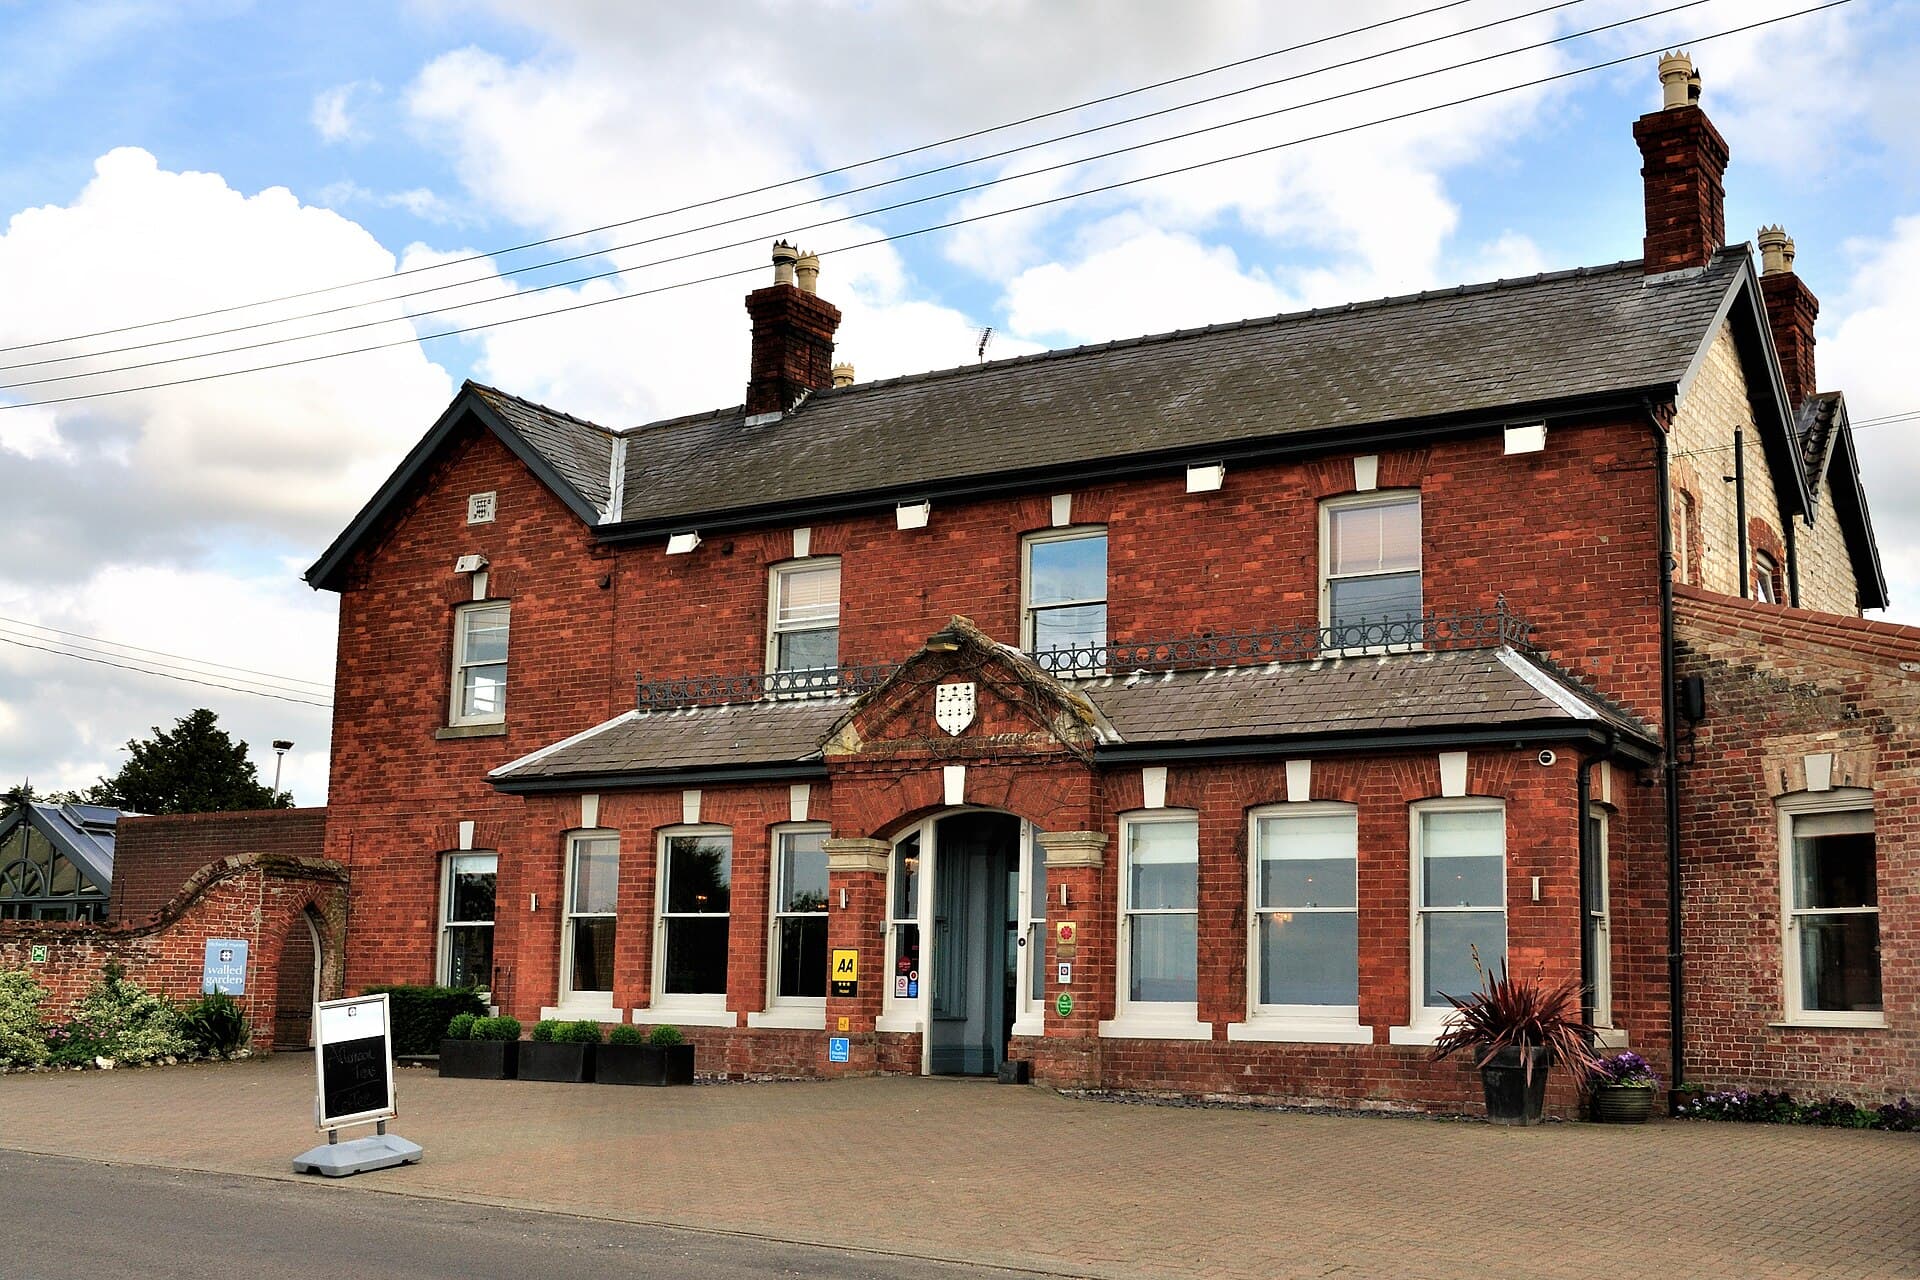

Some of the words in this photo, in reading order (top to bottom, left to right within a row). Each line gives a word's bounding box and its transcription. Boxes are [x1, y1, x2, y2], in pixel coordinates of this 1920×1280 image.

[208, 964, 242, 975] walled
[837, 958, 854, 973] AA
[206, 974, 242, 986] garden
